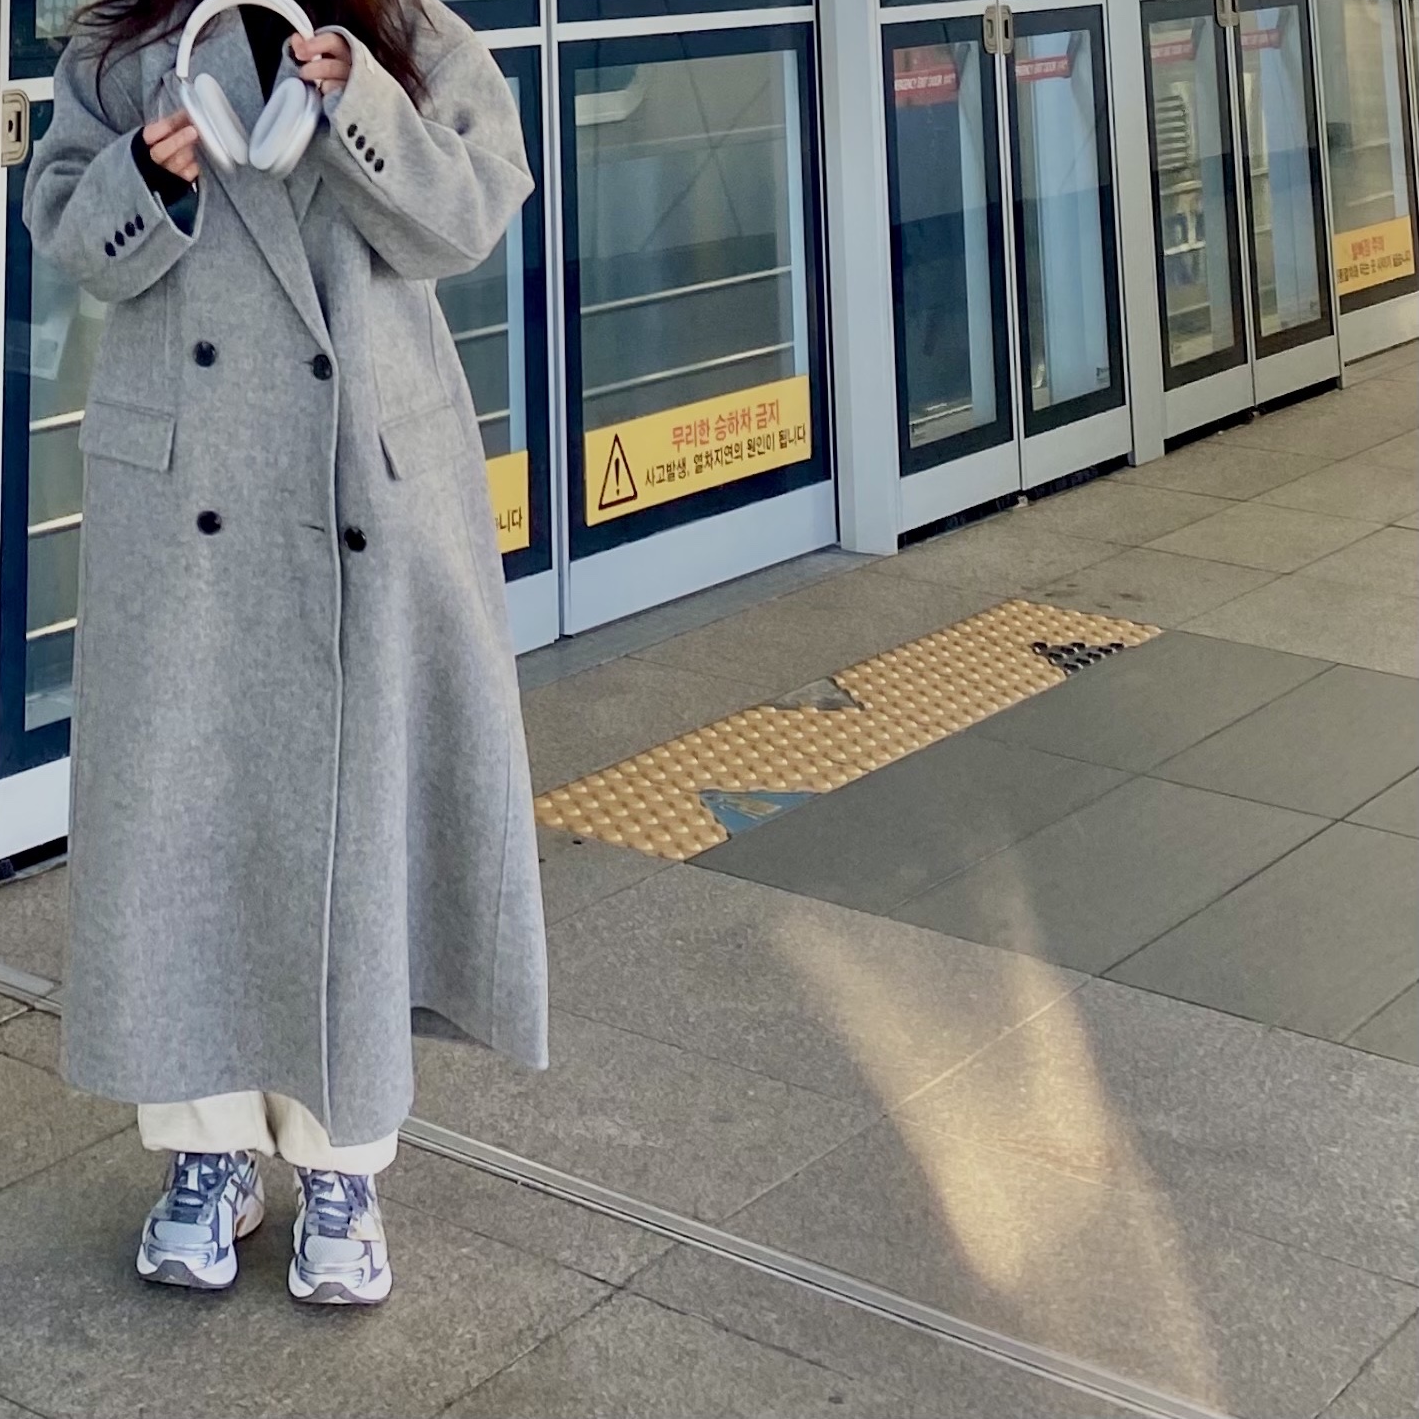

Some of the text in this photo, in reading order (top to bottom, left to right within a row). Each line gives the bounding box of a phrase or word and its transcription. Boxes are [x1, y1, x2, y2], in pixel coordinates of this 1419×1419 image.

[645, 422, 807, 488] 사고발생, 열차지연의 원인이 됩니다
[671, 399, 781, 454] 무리한 승하차 금지
